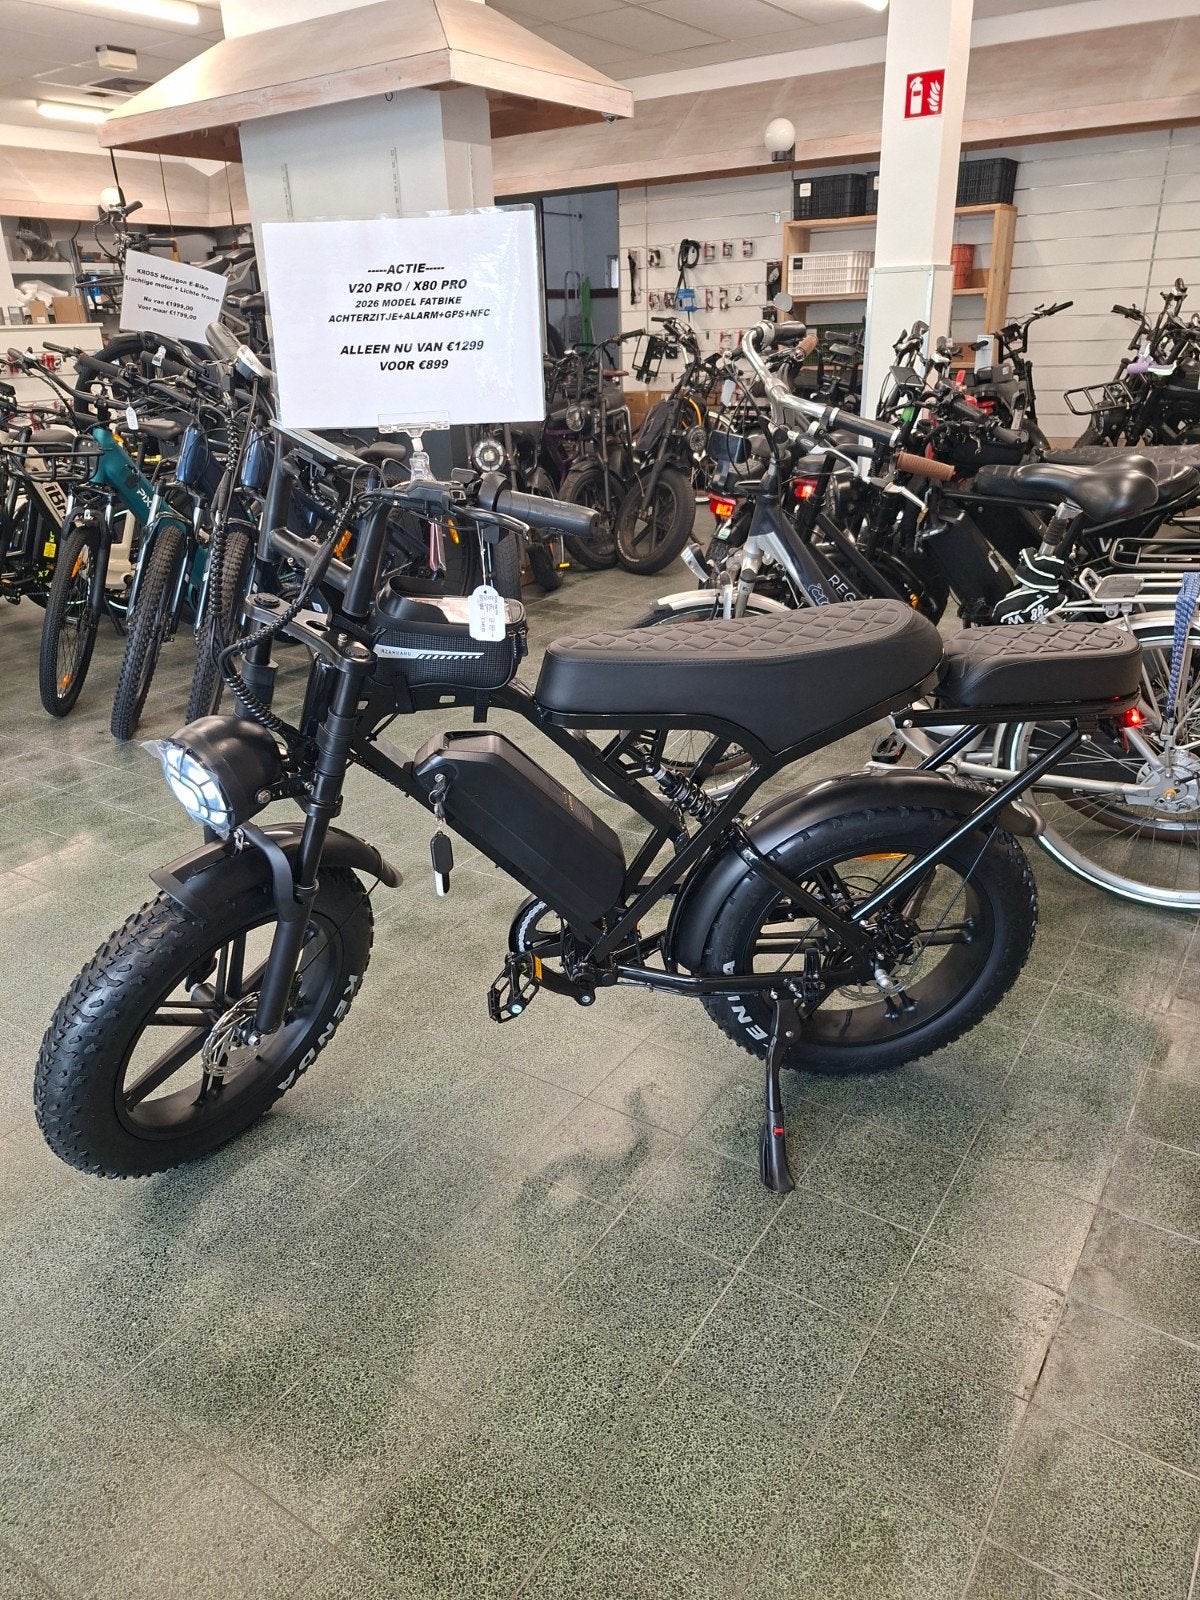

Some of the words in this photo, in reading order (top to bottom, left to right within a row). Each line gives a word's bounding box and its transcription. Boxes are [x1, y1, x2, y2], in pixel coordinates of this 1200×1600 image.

[136, 268, 159, 278] KROSS
[160, 273, 188, 285] Hexagon
[188, 280, 209, 291] E-Bike
[348, 283, 372, 293] V20
[375, 281, 401, 292] PRO
[405, 281, 410, 291] /
[412, 280, 437, 291] X80
[440, 279, 467, 290] PRO
[154, 282, 173, 290] motor
[180, 287, 200, 297] Lichte
[201, 293, 220, 303] frame
[166, 302, 194, 311] €1999,00
[355, 300, 379, 308] 2026
[382, 298, 416, 307] MODEL
[419, 296, 462, 306] FATBIKE
[137, 303, 151, 311] Voor
[169, 310, 197, 321] €1799,00
[328, 308, 490, 323] ACHTERZITJE+ALARM+GPS+NFC
[340, 344, 390, 355] ALLEEN
[394, 343, 413, 353] NU
[417, 342, 443, 352] VAN
[446, 340, 484, 351] €1299
[379, 360, 415, 371] VOOR
[418, 359, 449, 370] €899
[277, 974, 359, 1091] KENDA
